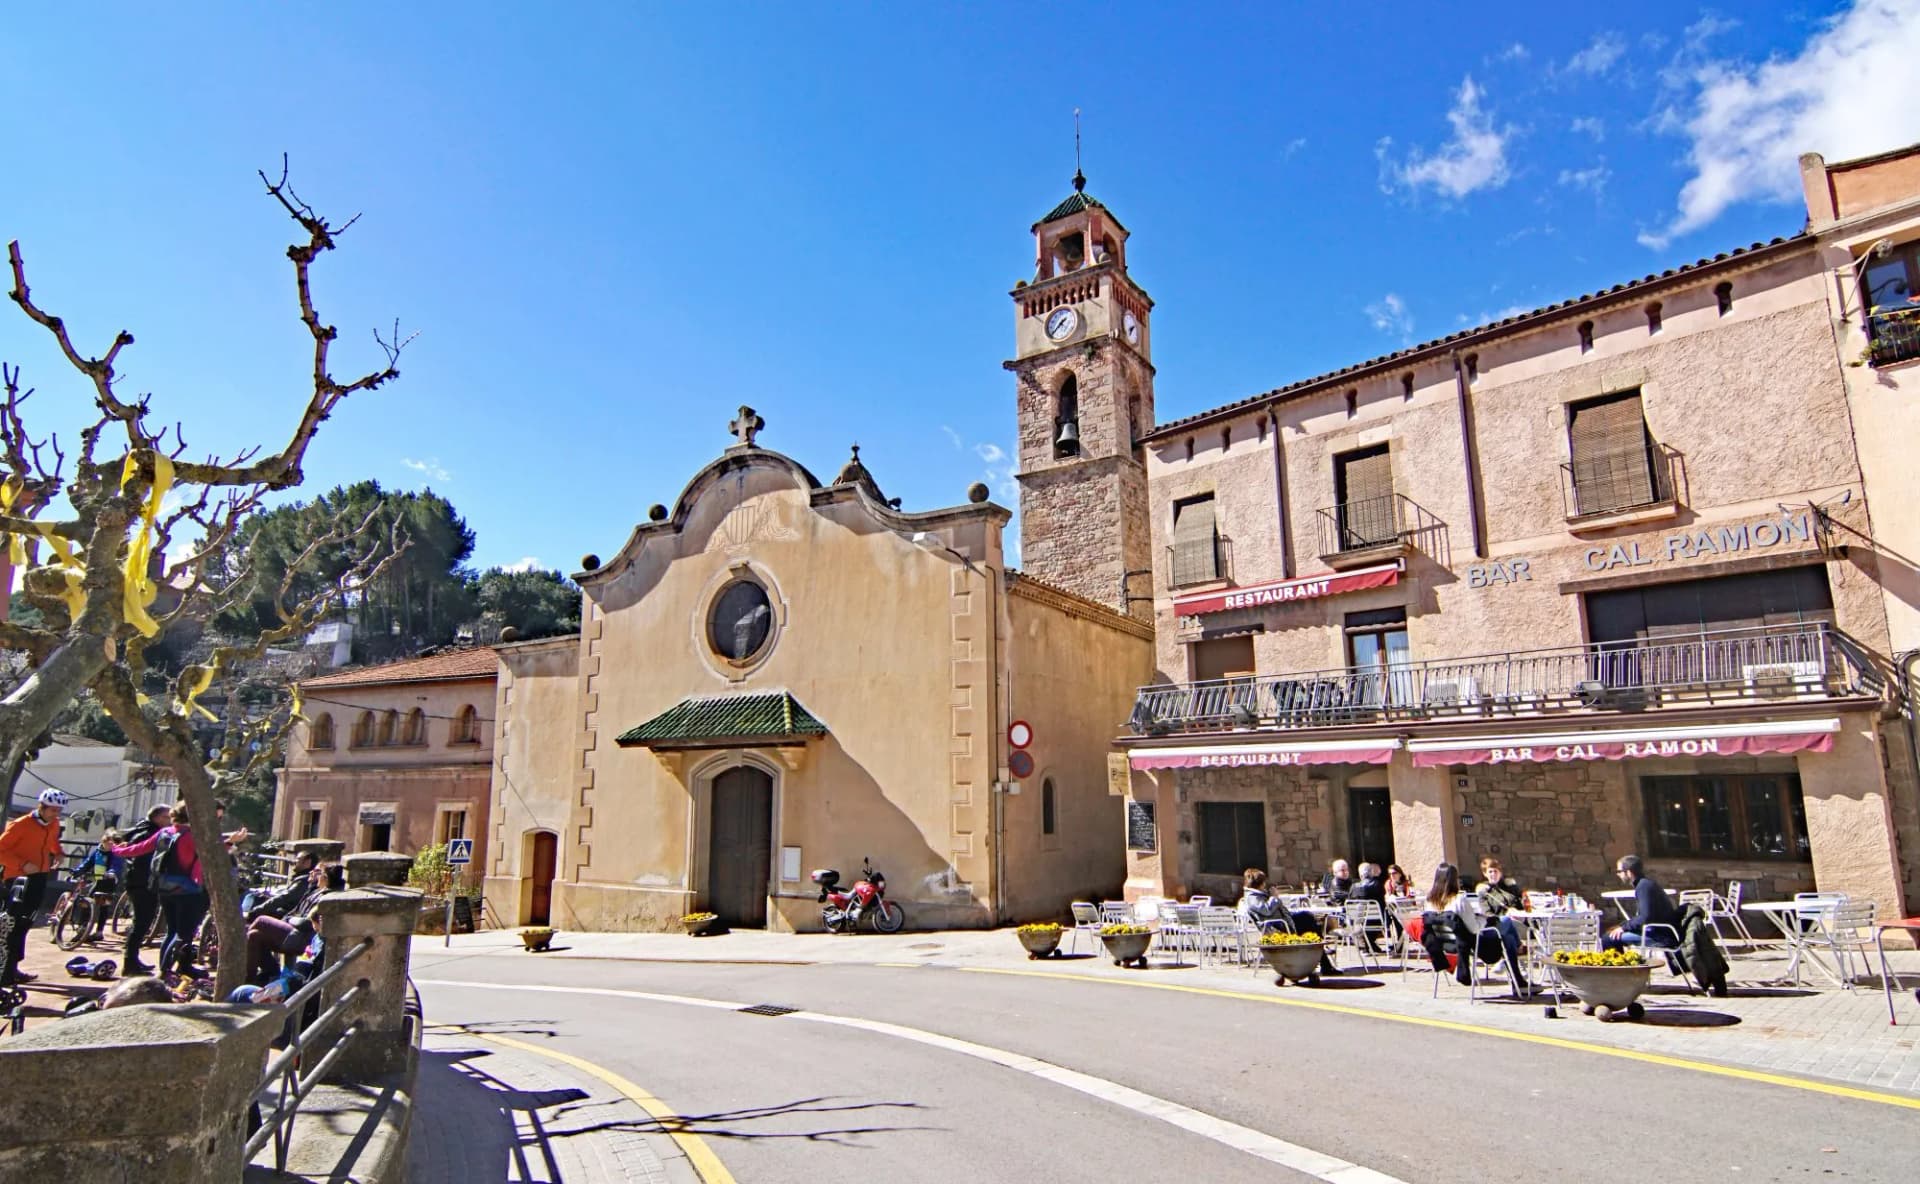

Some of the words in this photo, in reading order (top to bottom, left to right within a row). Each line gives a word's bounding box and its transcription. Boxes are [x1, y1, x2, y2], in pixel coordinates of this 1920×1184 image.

[1467, 556, 1532, 589] BAR
[1584, 540, 1651, 571] CAL
[1664, 513, 1810, 561] RAMON
[1225, 580, 1329, 608] RESTAURANT
[1200, 752, 1301, 767] RESTAURANT
[1491, 747, 1533, 761] BAR
[1555, 744, 1600, 759] CAL
[1624, 738, 1719, 756] RAMON
